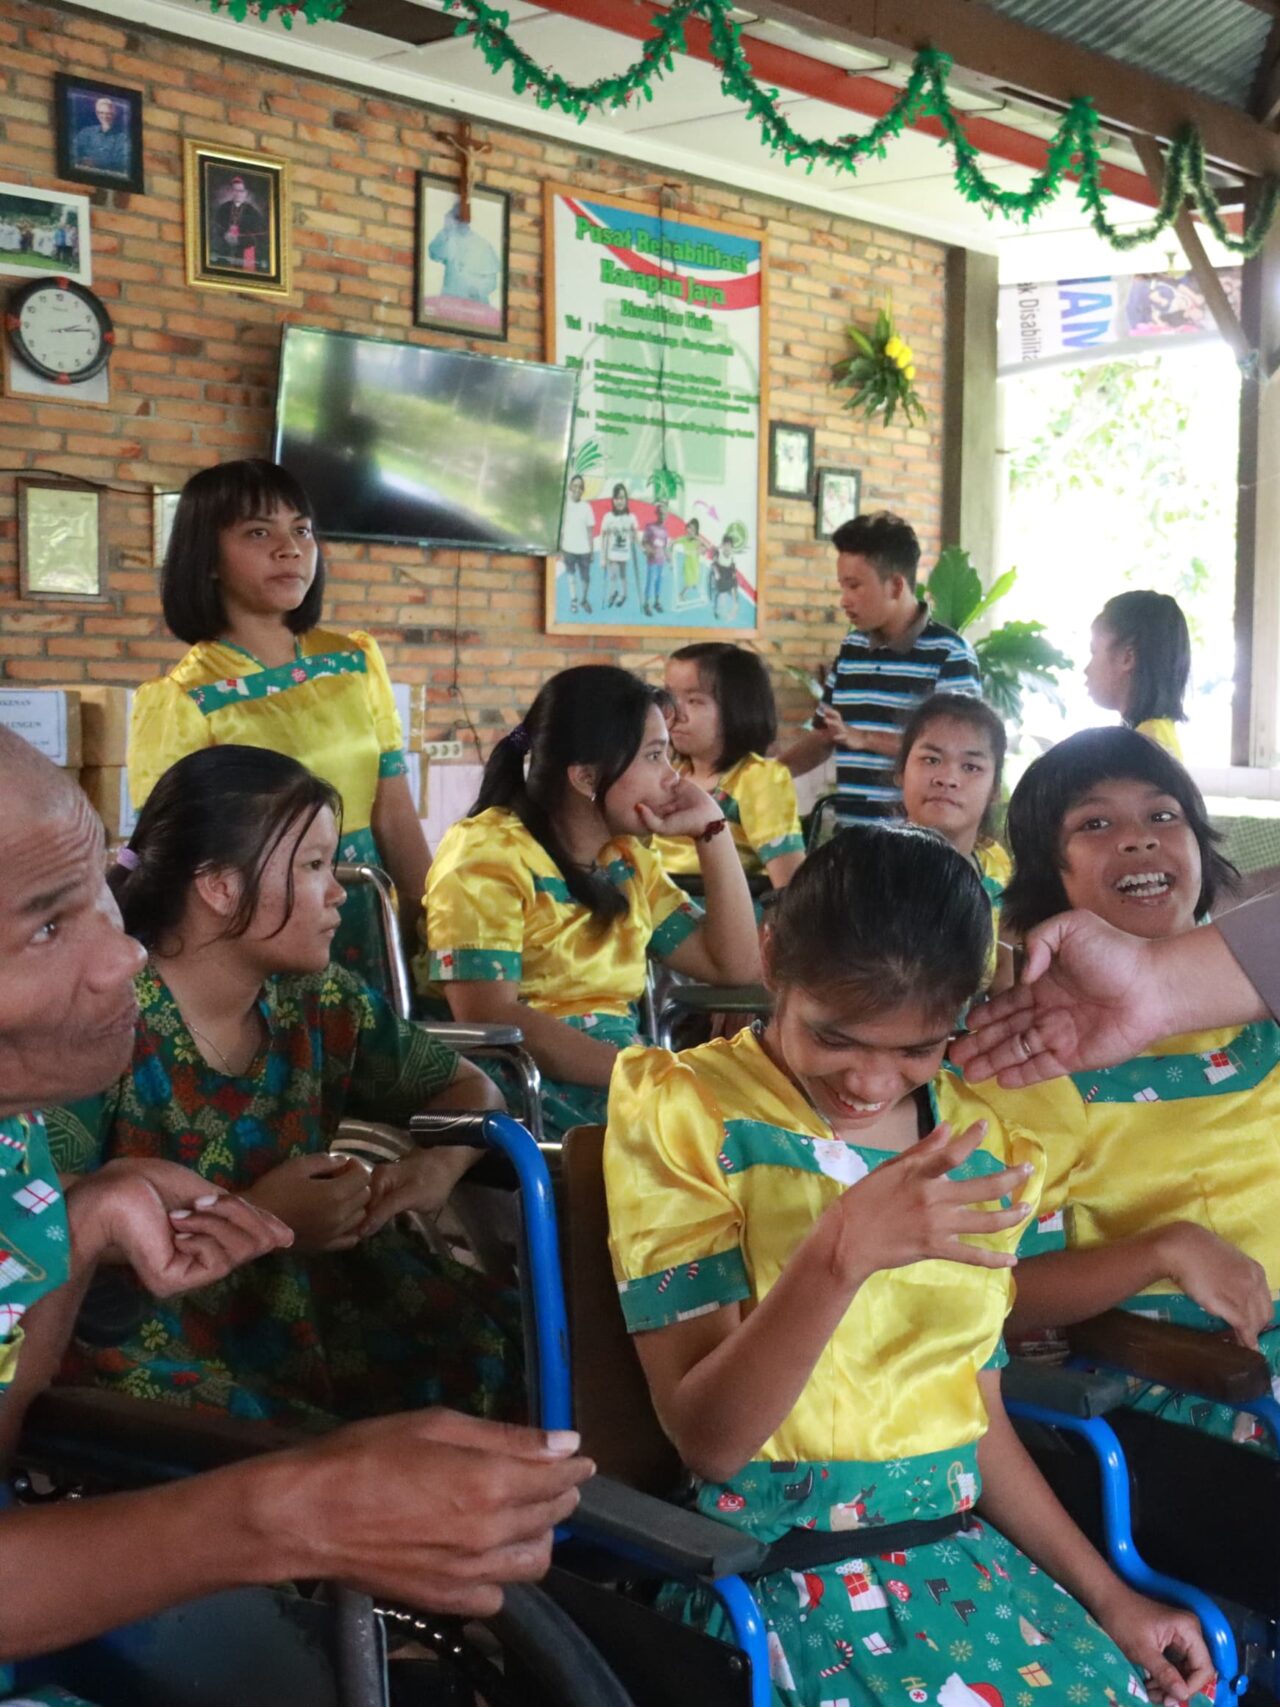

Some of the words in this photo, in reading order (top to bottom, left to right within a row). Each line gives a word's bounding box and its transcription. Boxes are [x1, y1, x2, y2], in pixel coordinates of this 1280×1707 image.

[575, 215, 633, 249] Pusat
[635, 228, 748, 274] Rehabilitasi
[686, 275, 727, 309] Jaya
